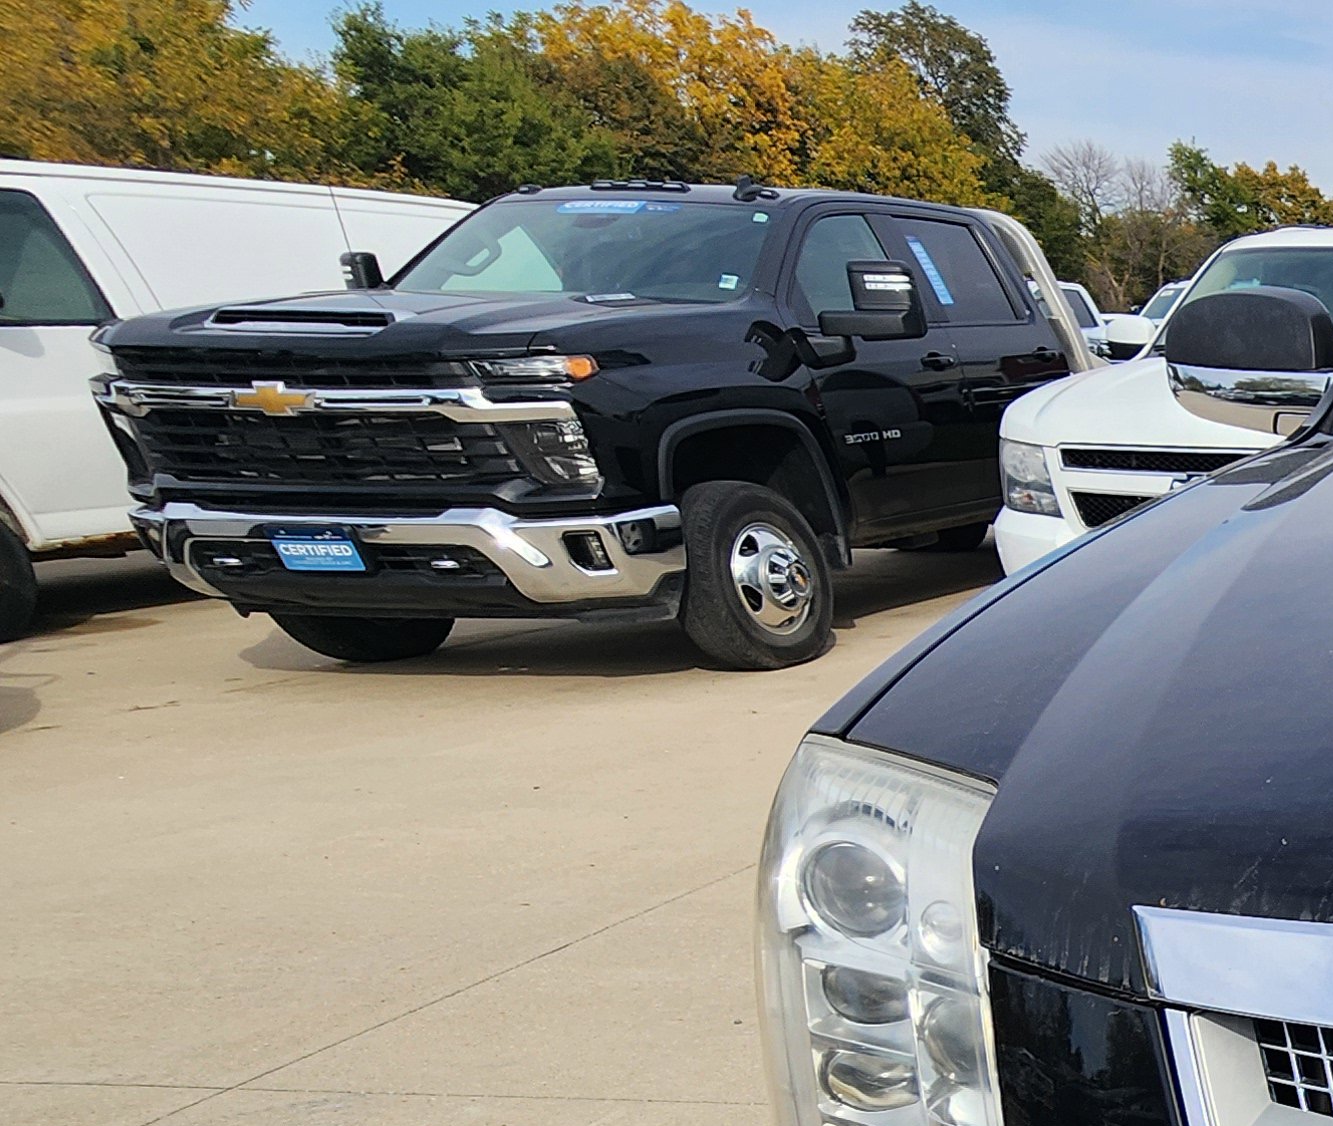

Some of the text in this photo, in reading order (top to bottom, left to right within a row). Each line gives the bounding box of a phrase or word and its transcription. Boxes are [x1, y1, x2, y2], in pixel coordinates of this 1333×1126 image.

[844, 429, 902, 445] 3500 HD
[279, 543, 353, 557] CERTIFIED
